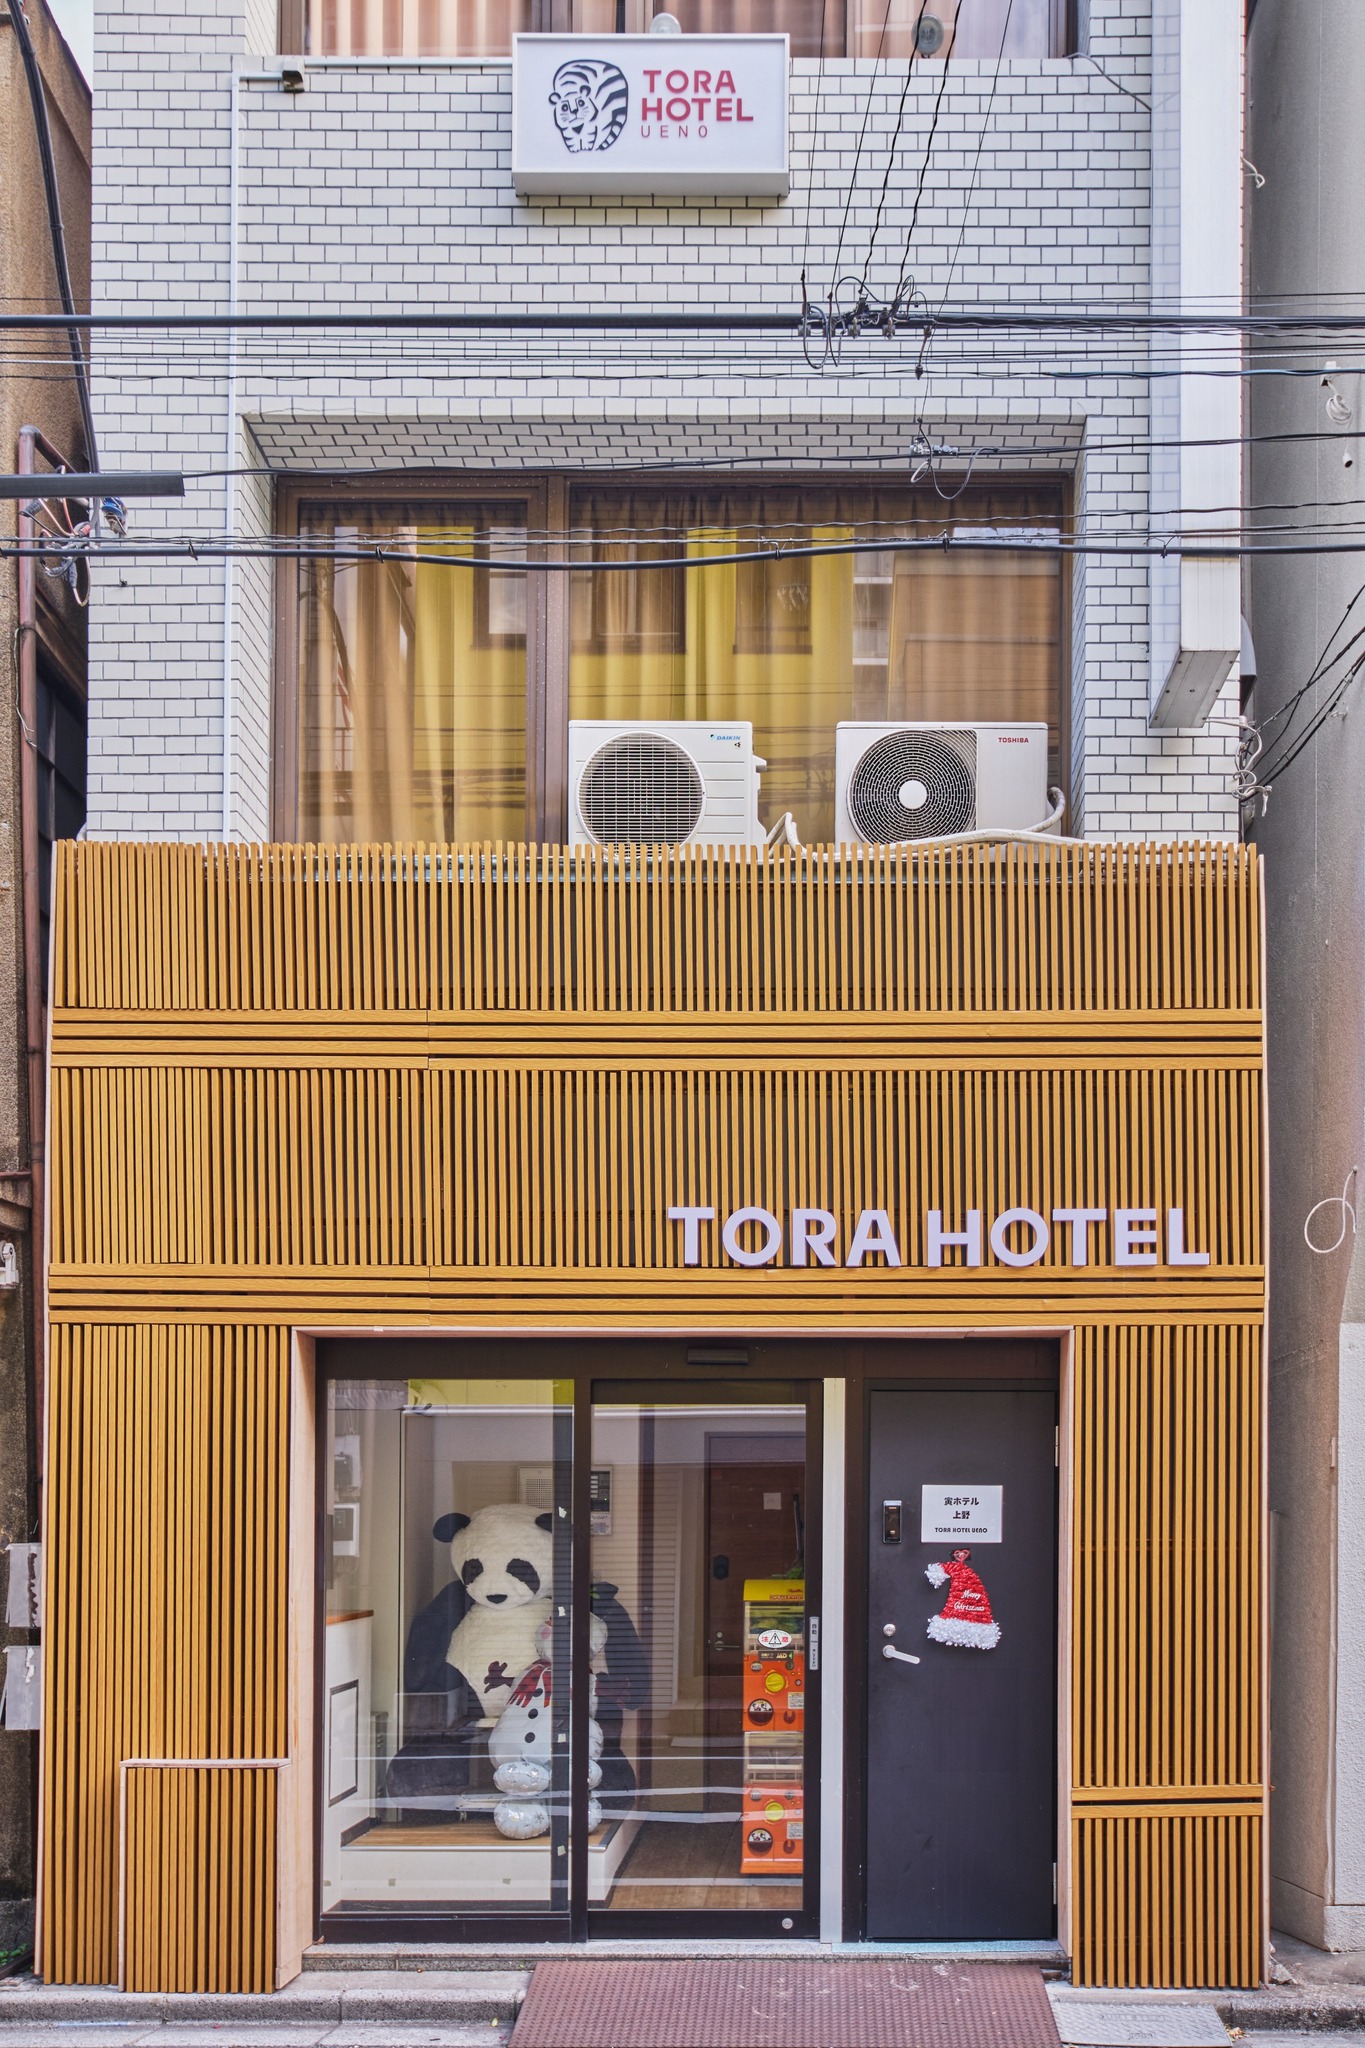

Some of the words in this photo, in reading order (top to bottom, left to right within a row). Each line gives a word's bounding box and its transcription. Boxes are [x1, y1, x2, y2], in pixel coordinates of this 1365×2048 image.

[642, 69, 736, 94] TORA
[641, 97, 754, 122] HOTEL
[640, 124, 708, 138] UENO
[667, 1206, 902, 1267] TORA
[927, 1207, 1210, 1268] HOTEL
[944, 1497, 980, 1506] 寅ホテル
[952, 1510, 970, 1520] 上野
[961, 1589, 981, 1600] Merry
